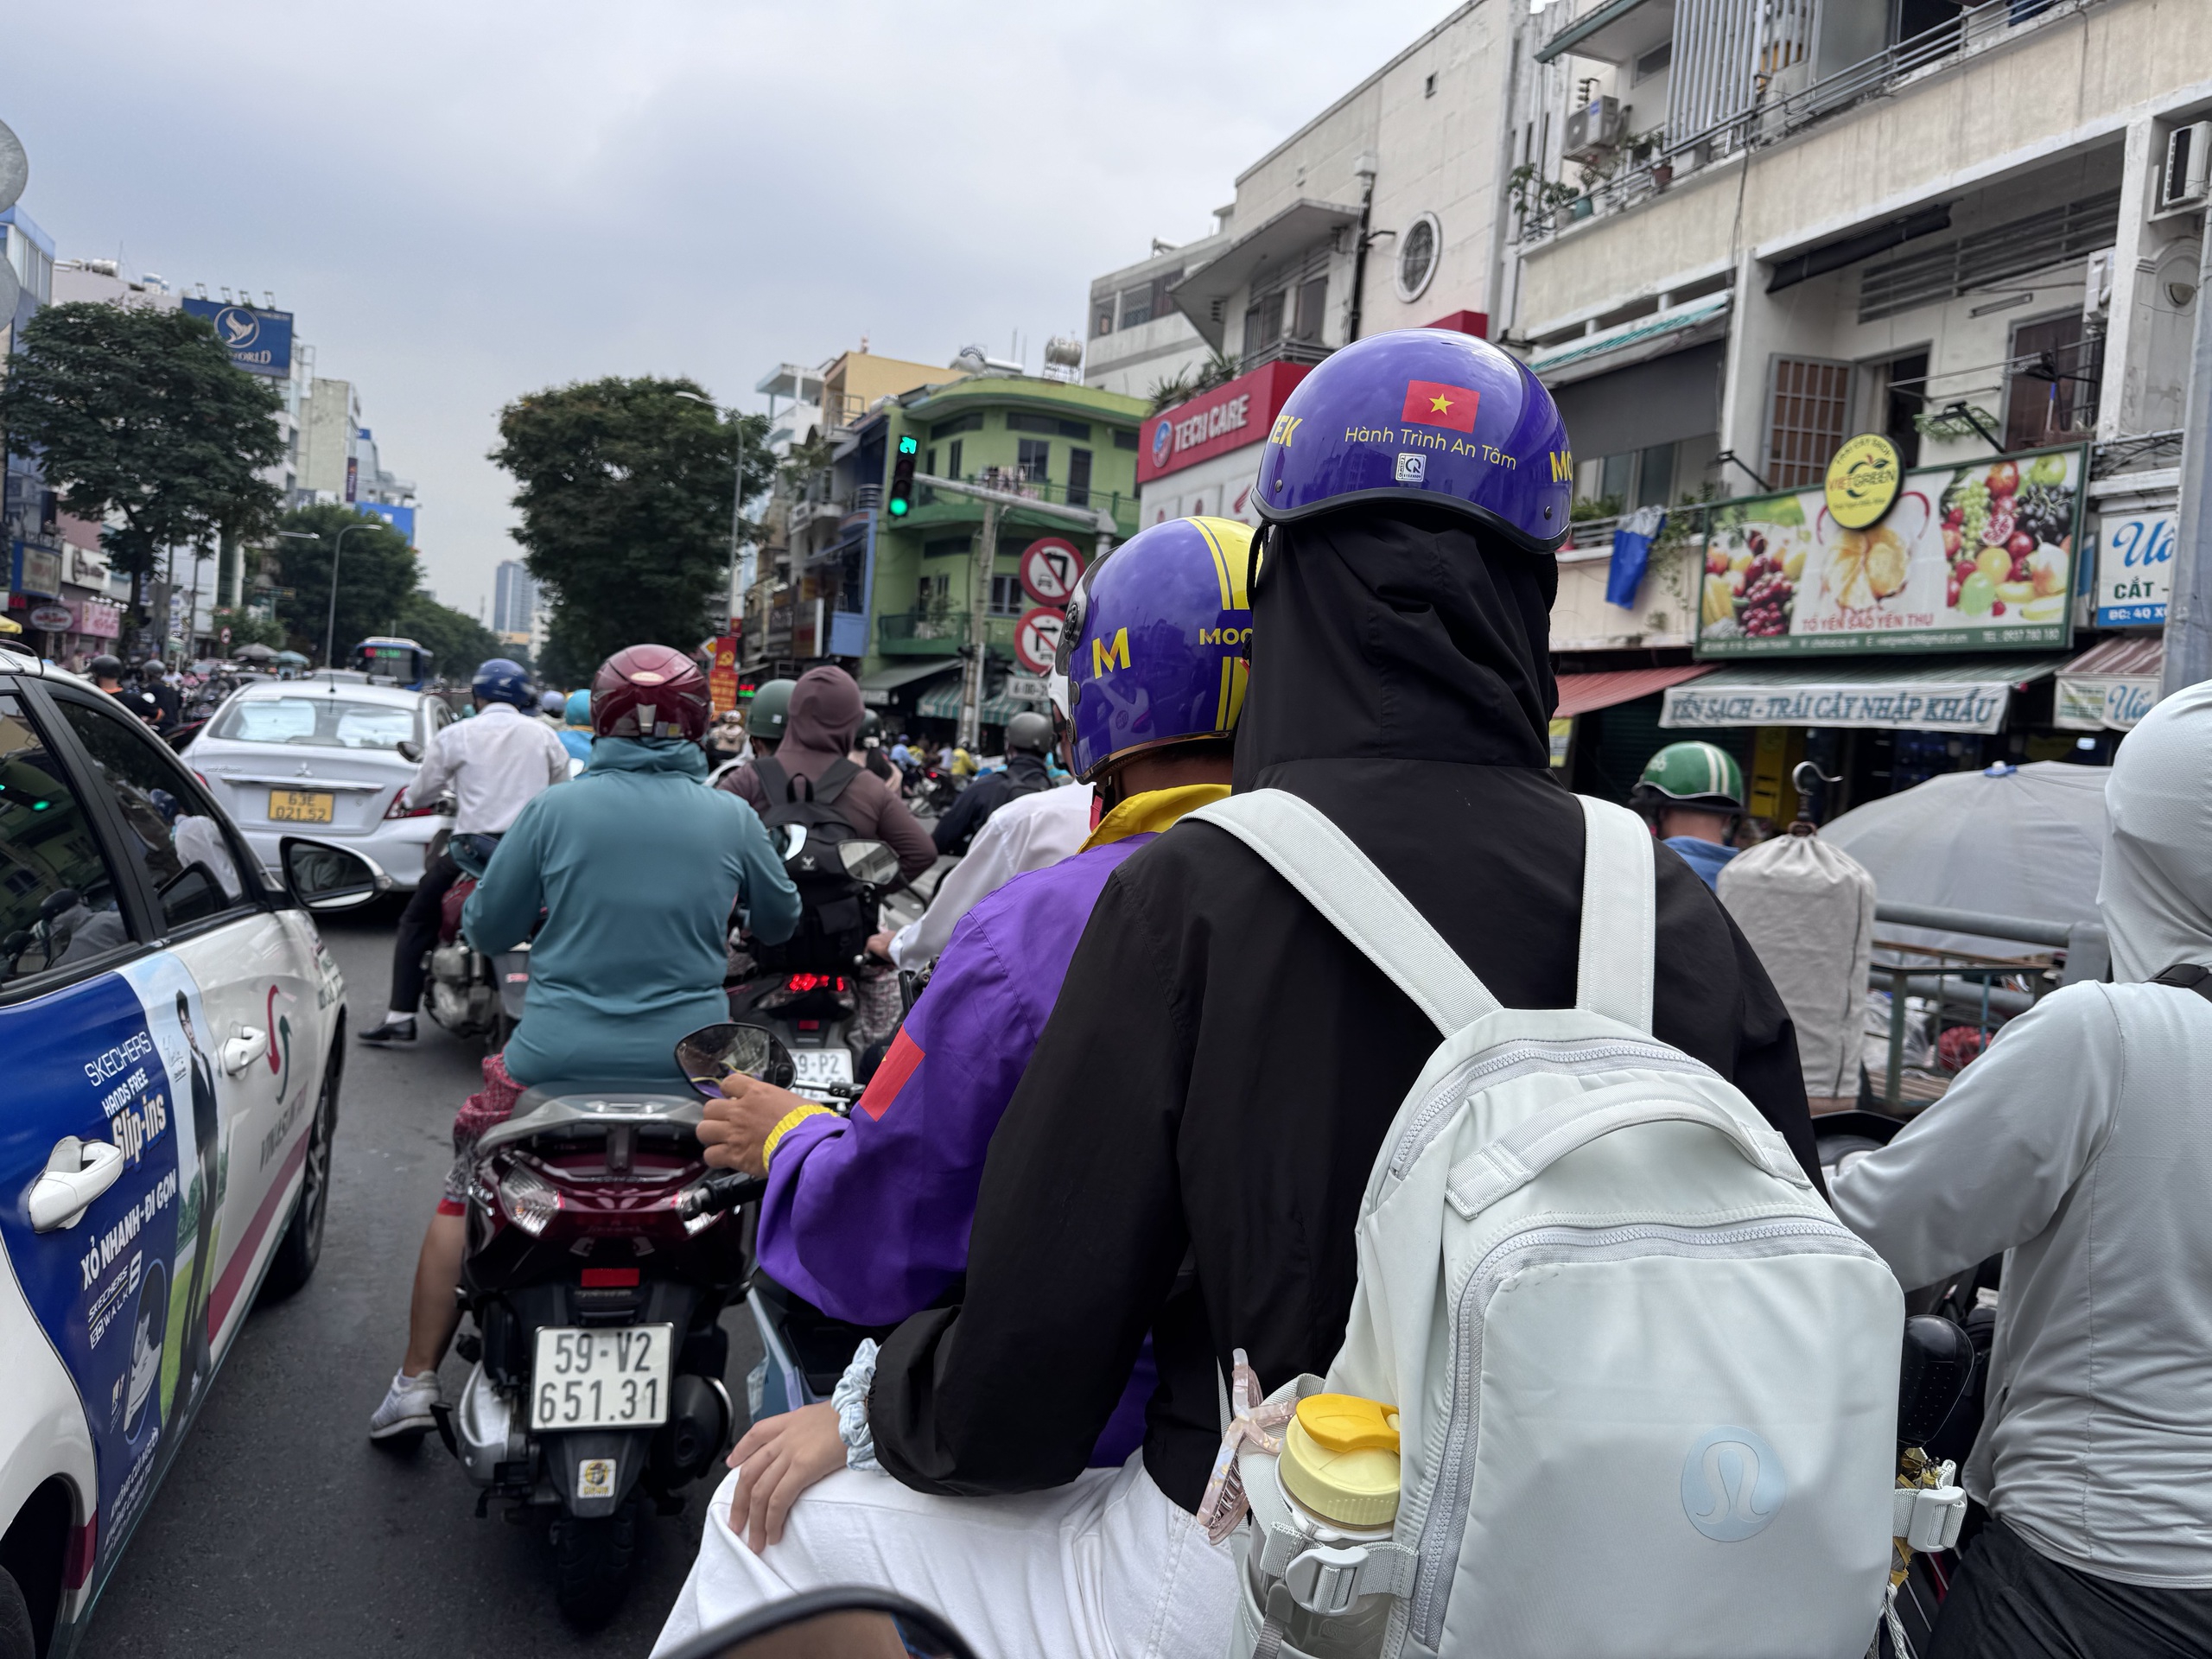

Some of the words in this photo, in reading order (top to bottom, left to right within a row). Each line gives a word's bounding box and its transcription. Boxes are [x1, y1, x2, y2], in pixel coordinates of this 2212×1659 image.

[1174, 412, 1209, 453] TECH
[1210, 393, 1250, 439] CARE
[1344, 426, 1394, 442] Hành
[1401, 429, 1446, 451] Trình
[1450, 438, 1476, 458] An
[1481, 444, 1517, 471] Tâm
[2114, 575, 2155, 600] CẮT
[1092, 626, 1131, 679] M
[1768, 691, 1812, 719] TRÁI
[85, 1031, 152, 1087] SKECHERS
[792, 1054, 841, 1075] 9-P2
[101, 1082, 131, 1118] HANDS
[127, 1067, 149, 1096] FREE
[112, 1093, 167, 1164] Slip-ins
[80, 1235, 100, 1292] XỎ
[156, 1168, 176, 1210] GỌN
[88, 1264, 129, 1323] SKECHERS
[554, 1331, 653, 1374] 59-V2
[538, 1377, 658, 1423] 651.31
